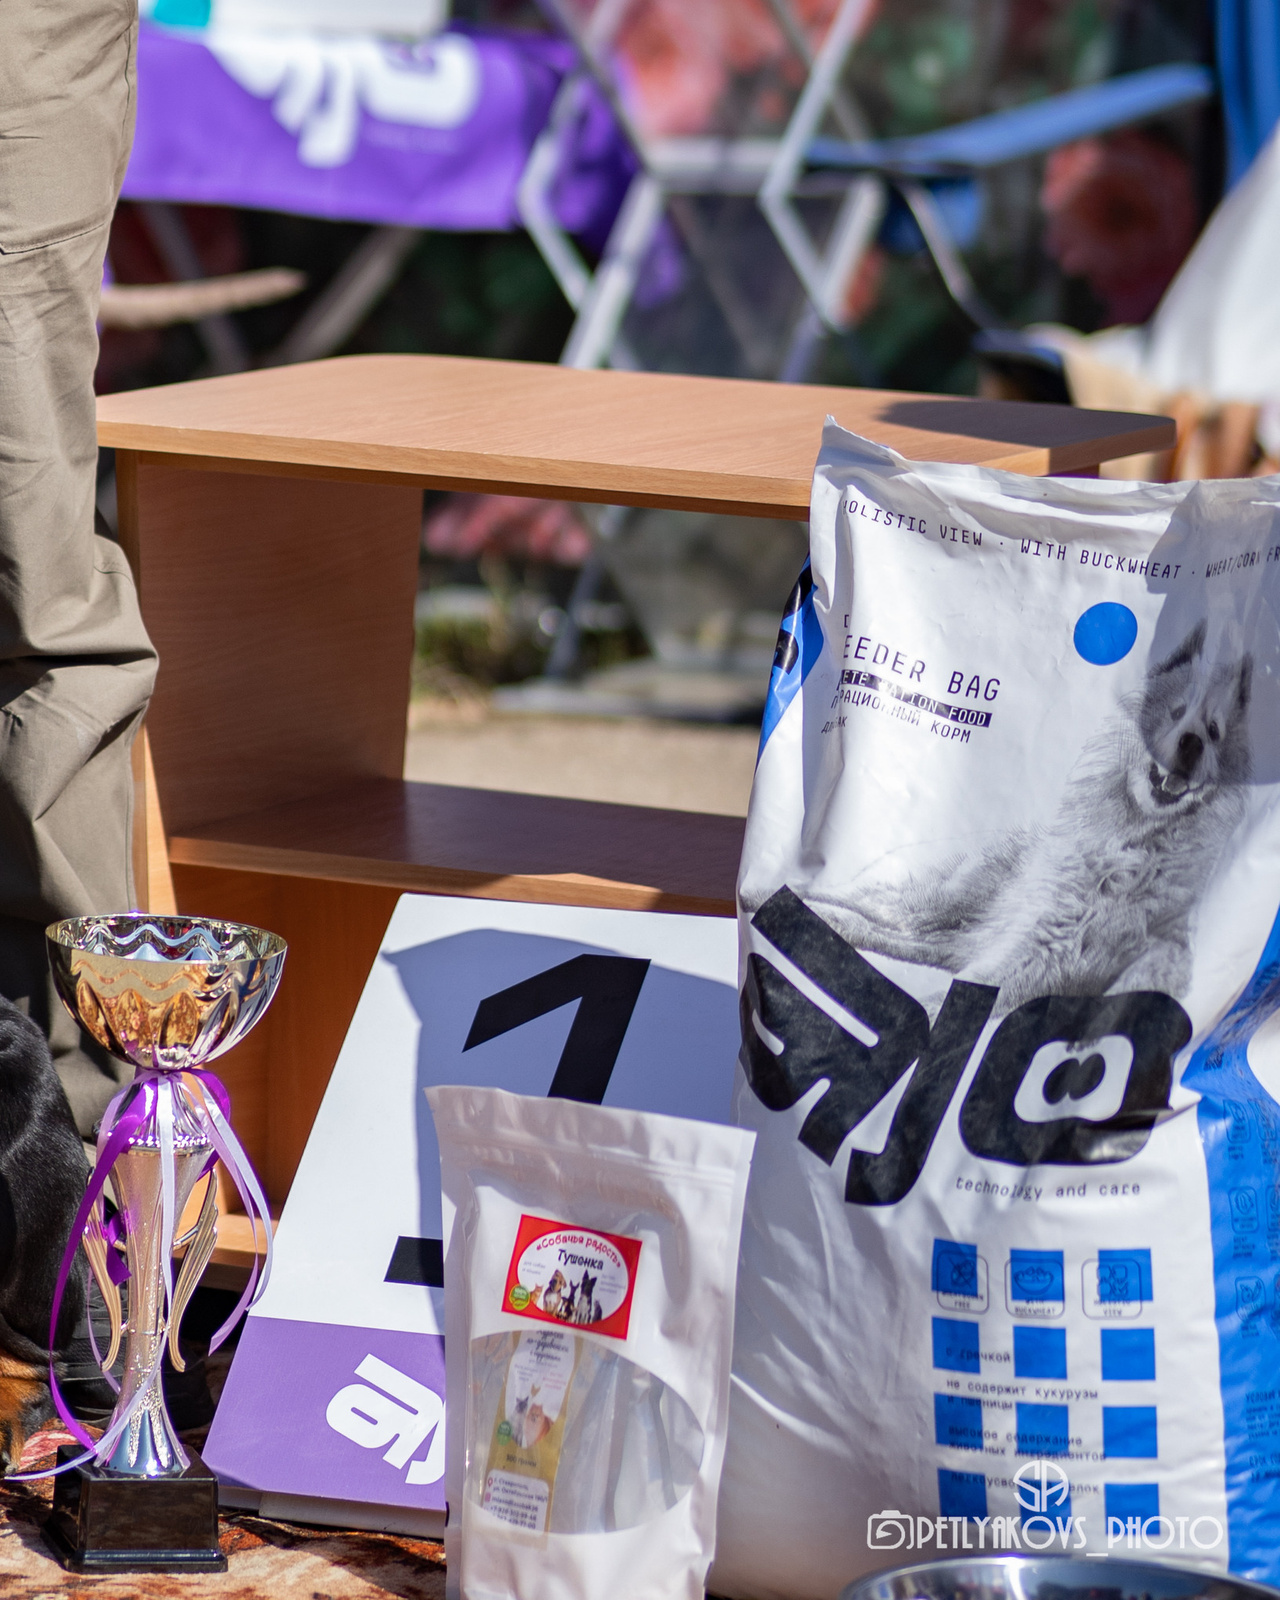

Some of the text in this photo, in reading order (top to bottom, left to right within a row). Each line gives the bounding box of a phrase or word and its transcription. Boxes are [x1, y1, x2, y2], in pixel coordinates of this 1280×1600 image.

[939, 524, 983, 546] VIEW
[1020, 538, 1067, 561] WITH
[1080, 549, 1181, 580] BUCKWHEAT
[947, 670, 1001, 702] BAG
[948, 706, 987, 726] FOOD
[930, 719, 972, 744] КОРМ
[1055, 1182, 1087, 1198] and
[1098, 1183, 1141, 1197] care
[967, 1381, 1026, 1396] содержит
[1035, 1387, 1098, 1401] кукурузы
[1006, 1431, 1083, 1446] содержание
